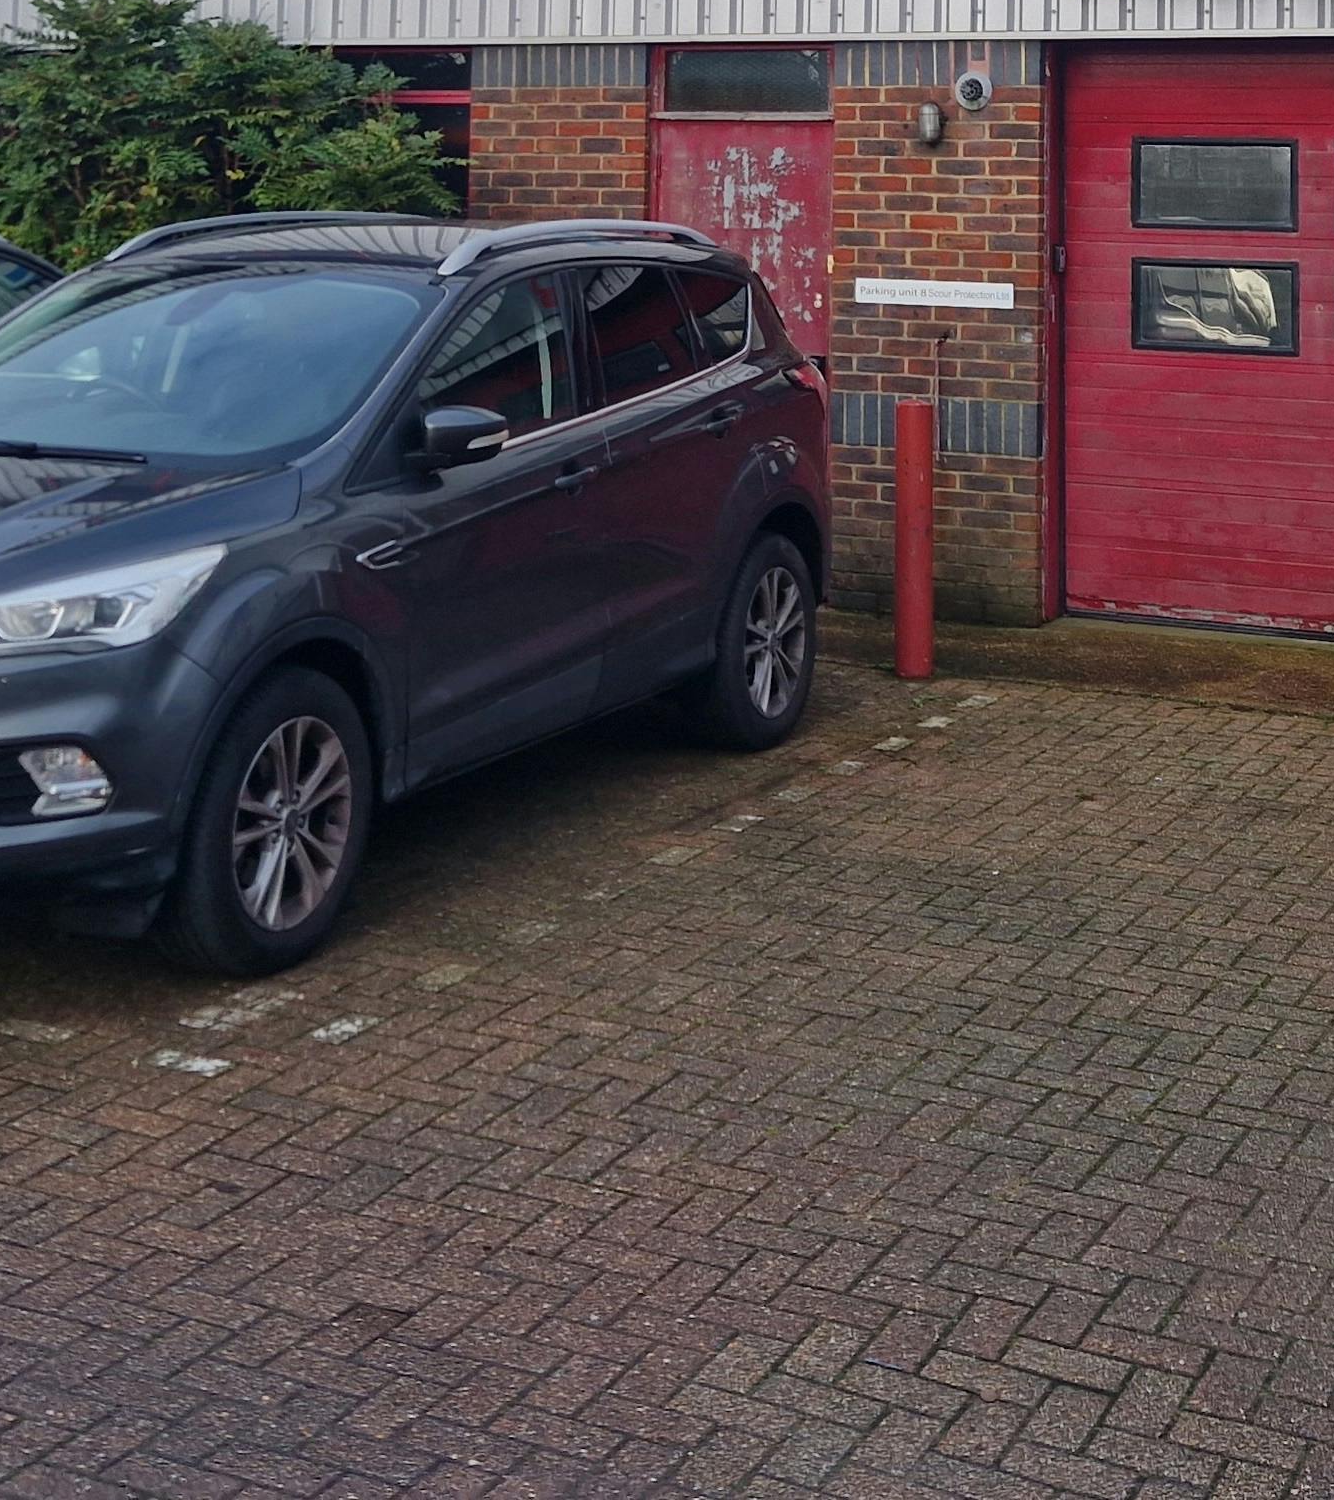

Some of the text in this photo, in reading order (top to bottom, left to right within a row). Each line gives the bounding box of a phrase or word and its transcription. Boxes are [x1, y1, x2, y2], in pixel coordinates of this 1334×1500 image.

[859, 285, 897, 298] Parking
[898, 288, 918, 298] unit
[928, 289, 952, 299] Scour
[954, 289, 996, 301] Protection
[996, 291, 1011, 301] Ltd
